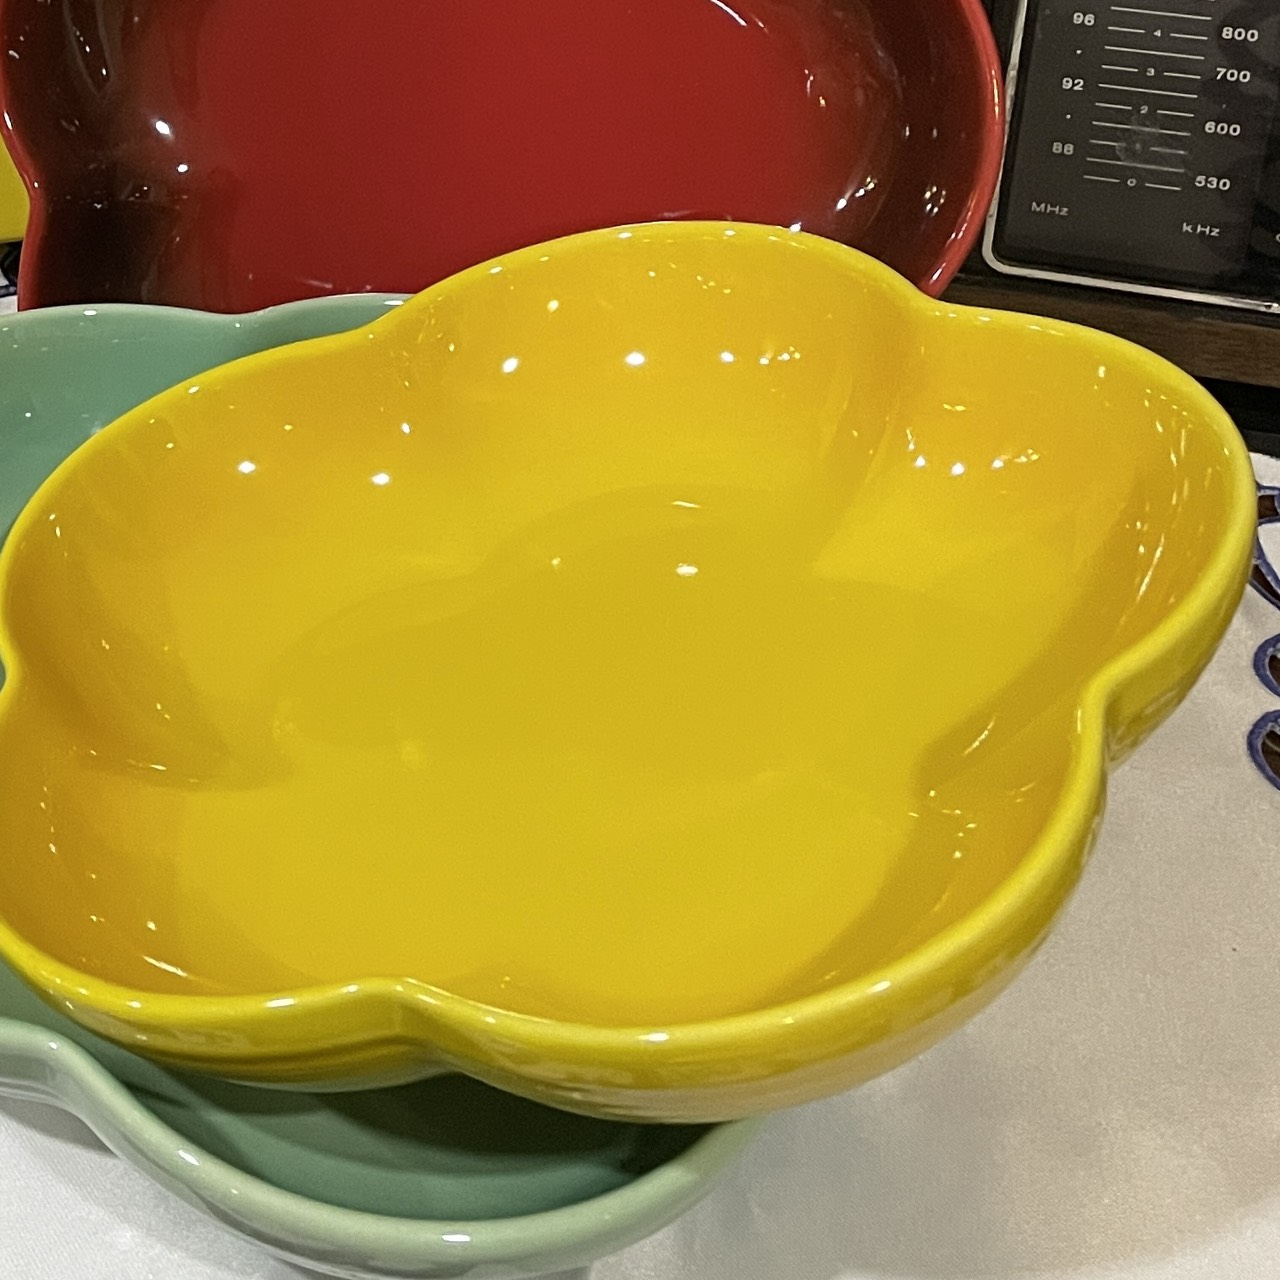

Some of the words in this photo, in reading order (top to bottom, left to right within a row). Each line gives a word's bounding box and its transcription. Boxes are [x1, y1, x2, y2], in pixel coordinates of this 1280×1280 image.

[1073, 12, 1095, 26] 96
[1153, 29, 1162, 37] 4
[1221, 26, 1259, 42] 800
[1146, 67, 1155, 77] 3
[1216, 67, 1251, 83] 700
[1062, 77, 1084, 91] 92
[1140, 105, 1149, 114] 2
[1204, 121, 1241, 136] 600
[1052, 141, 1074, 156] 88
[1194, 175, 1231, 191] 530
[1031, 201, 1069, 216] MHz
[1182, 222, 1220, 237] kHz
